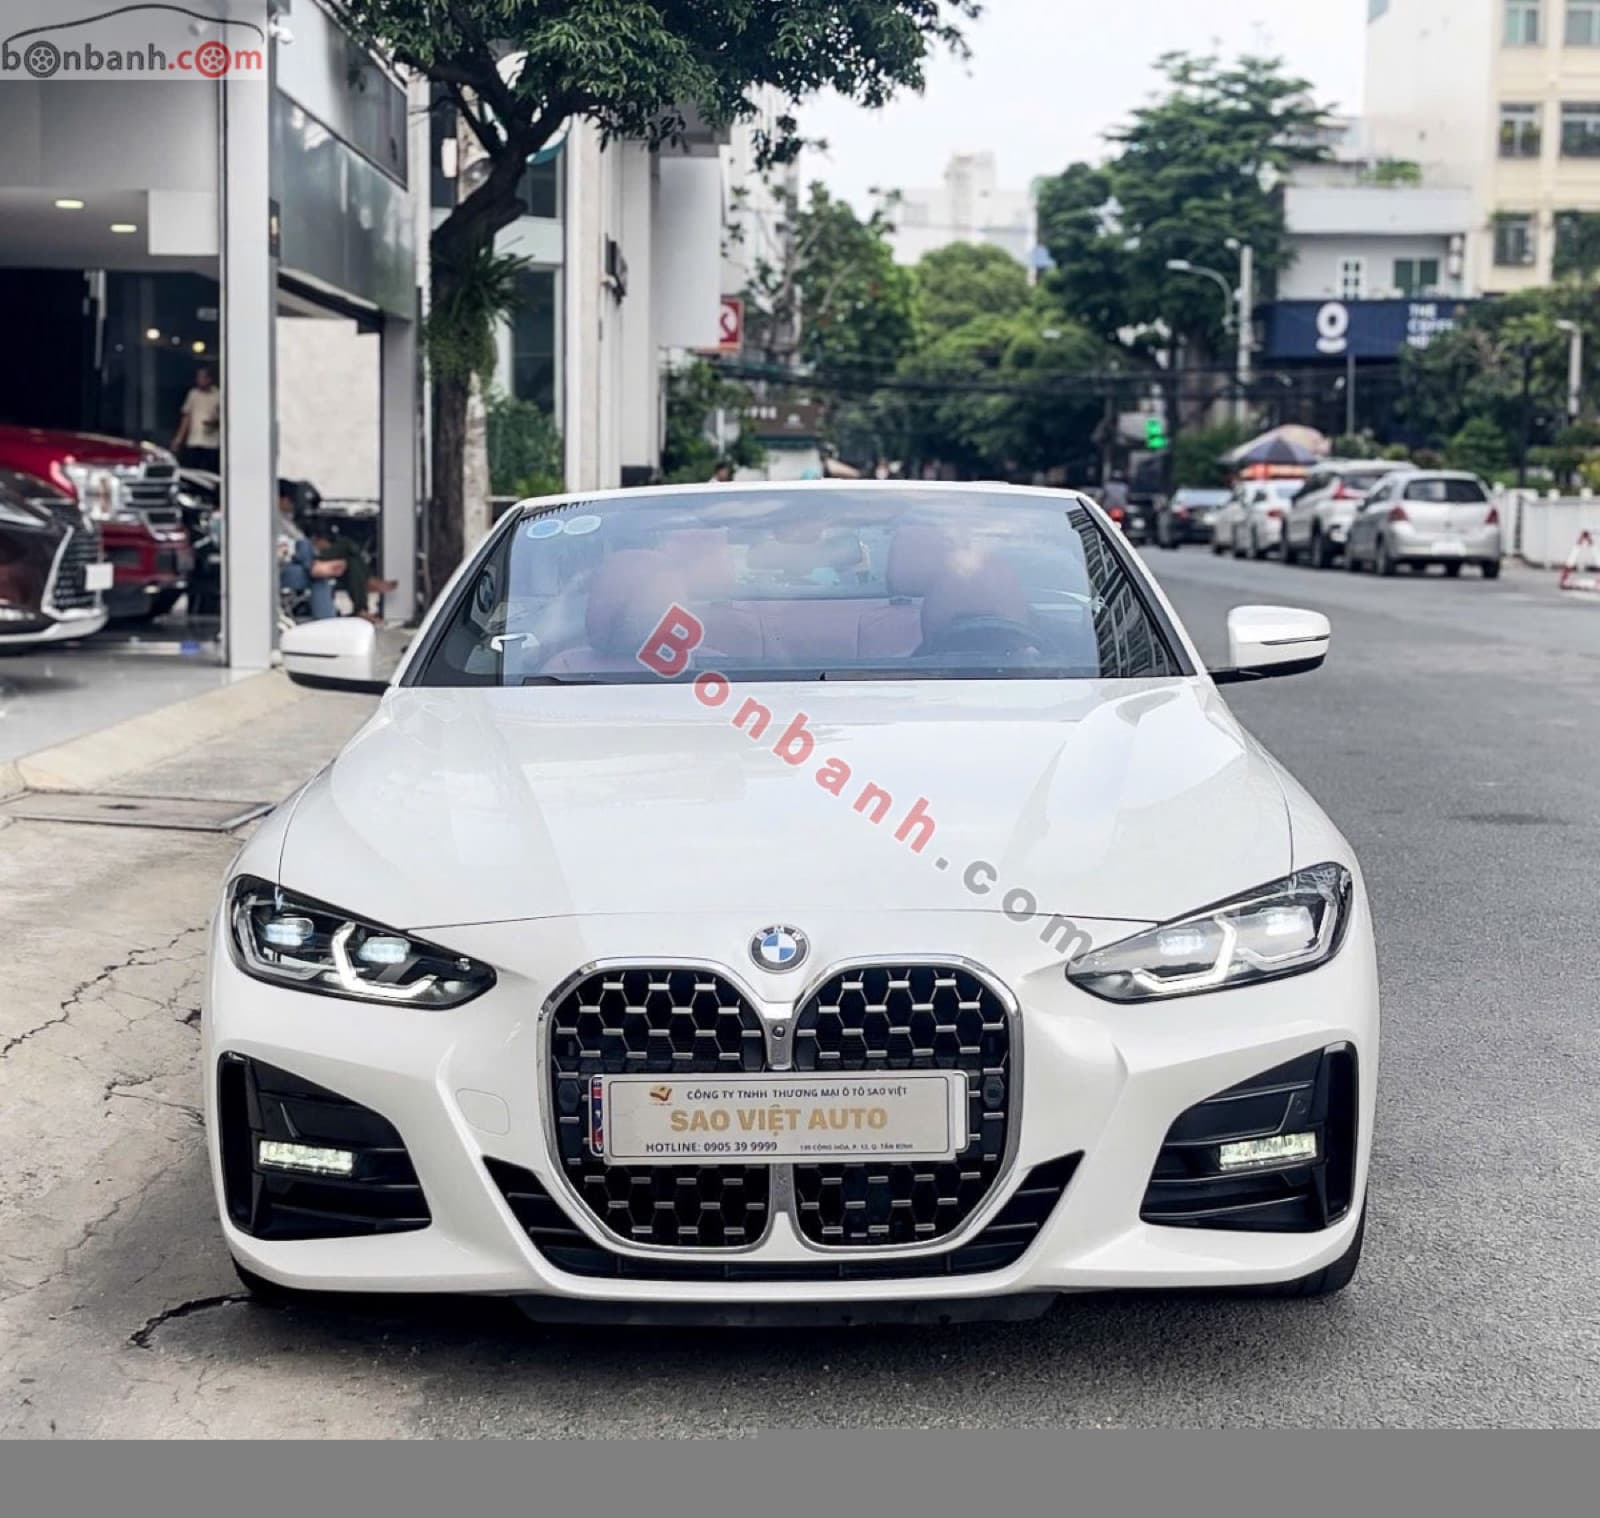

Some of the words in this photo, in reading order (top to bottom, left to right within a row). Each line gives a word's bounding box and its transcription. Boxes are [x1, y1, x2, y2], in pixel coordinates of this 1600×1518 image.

[687, 1087, 719, 1100] CÔNG
[722, 1089, 735, 1099] TY
[738, 1089, 768, 1099] TNHH
[773, 1087, 818, 1098] THƯƠNG
[842, 1085, 850, 1097] Ô
[852, 1085, 865, 1097] TÔ
[867, 1086, 886, 1096] SAO
[670, 1108, 730, 1133] SAO
[737, 1103, 801, 1137] VIỆT
[808, 1107, 888, 1130] AUTO
[646, 1141, 700, 1153] HOTLINE:
[703, 1141, 731, 1153] 0905
[734, 1141, 748, 1153] 39
[750, 1141, 778, 1153] 9999
